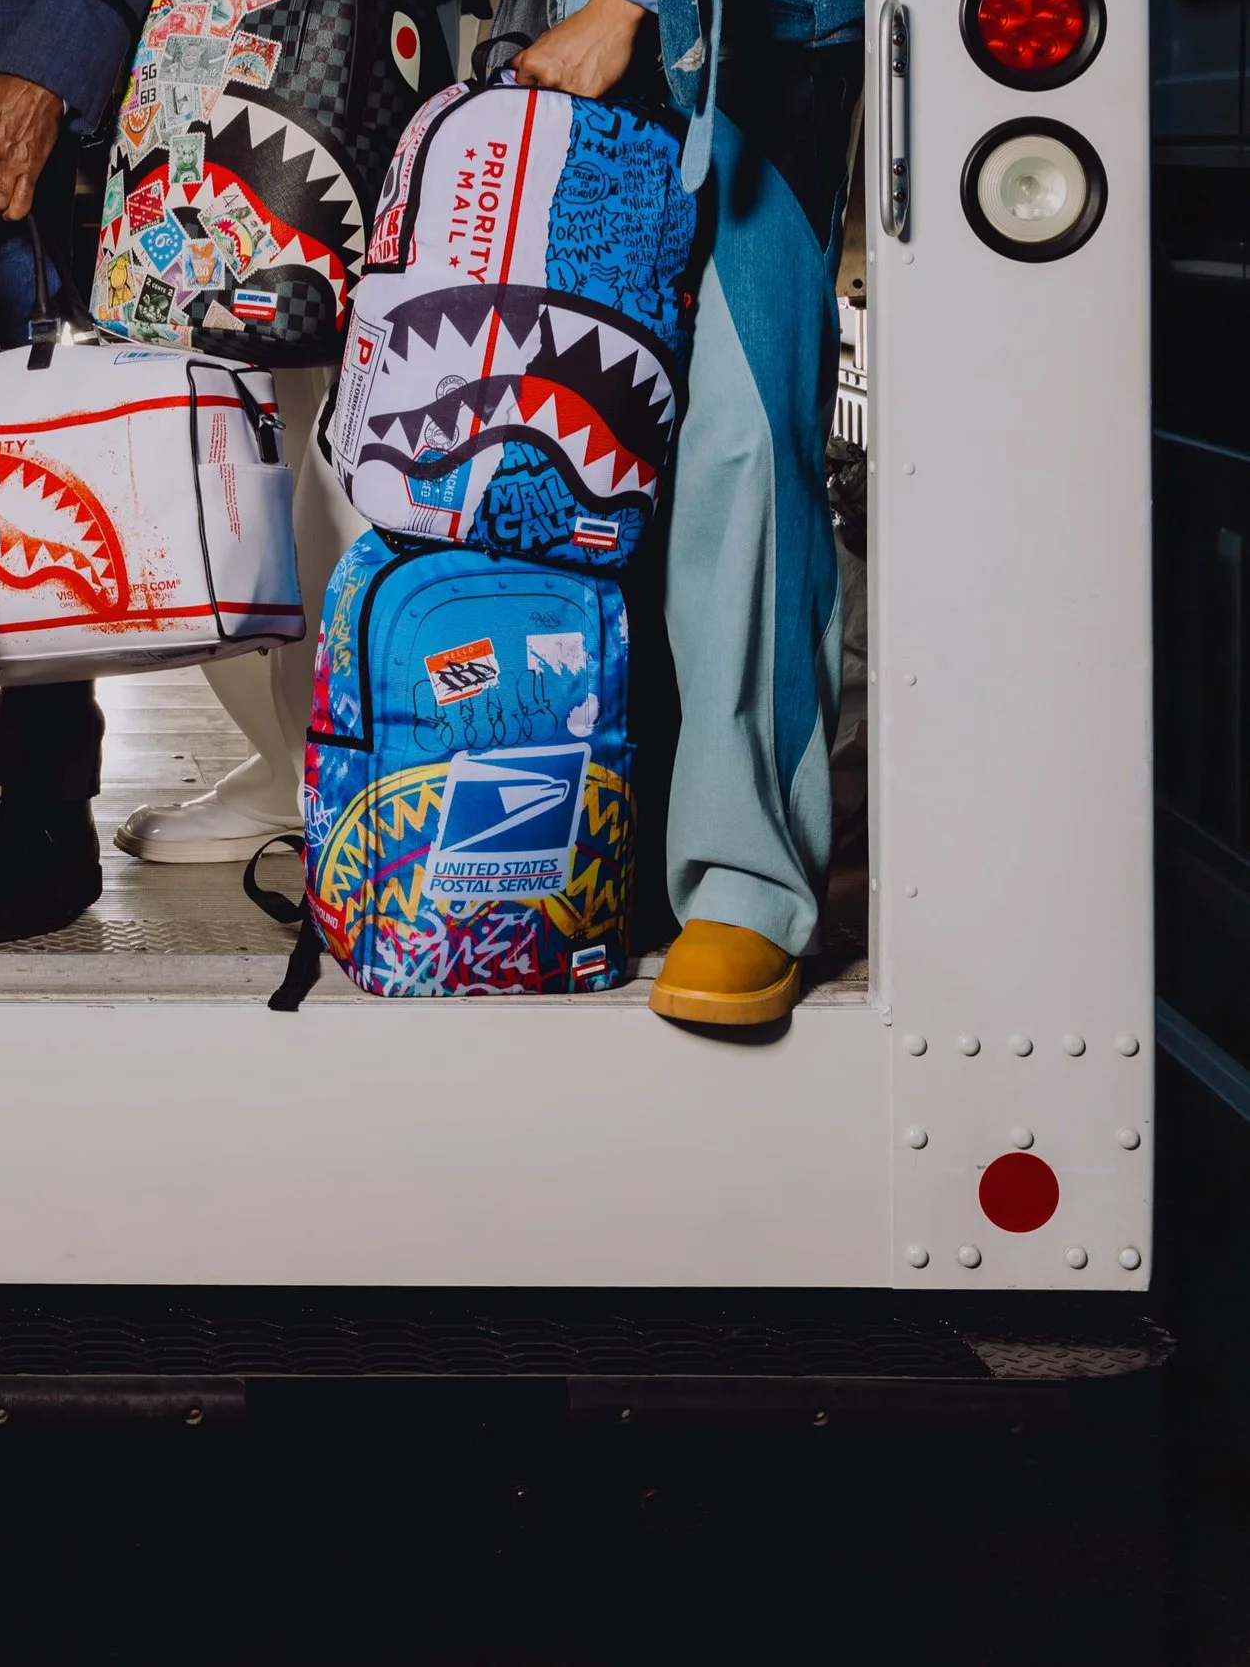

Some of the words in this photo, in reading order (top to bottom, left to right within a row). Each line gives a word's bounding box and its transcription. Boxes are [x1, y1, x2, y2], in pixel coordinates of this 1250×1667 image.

[141, 64, 157, 82] SG
[140, 87, 157, 105] 613
[573, 170, 600, 183] RETURN
[568, 187, 599, 200] SENDER
[448, 170, 476, 243] MAIL
[467, 141, 508, 285] PRIORITY
[145, 277, 152, 285] 2
[151, 282, 167, 292] CENTS
[167, 287, 174, 296] 2
[357, 336, 374, 366] P
[489, 475, 576, 518] MAIL
[442, 646, 474, 662] HELLO
[434, 861, 500, 876] UNITED
[502, 858, 558, 876] STATES
[429, 878, 493, 893] POSTAL
[496, 875, 562, 892] SERVICE
